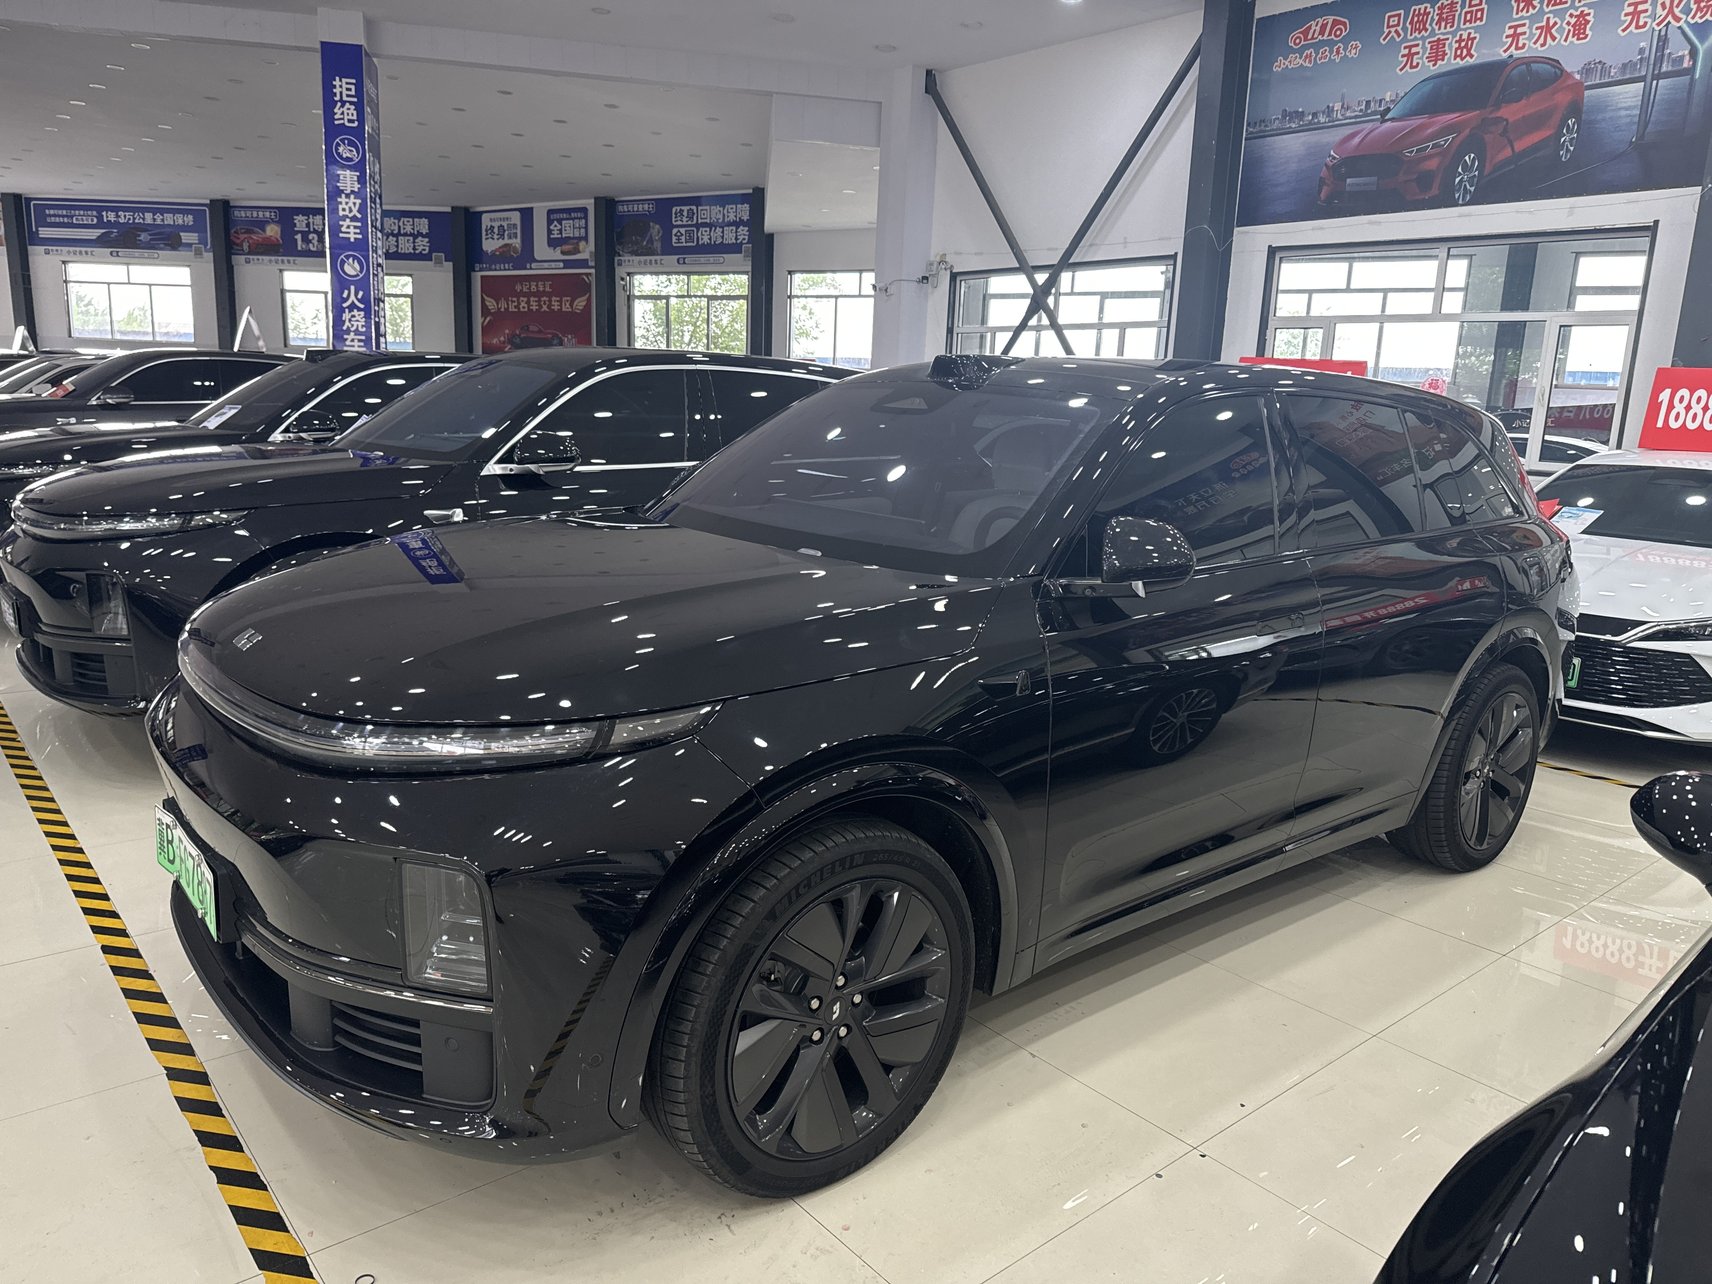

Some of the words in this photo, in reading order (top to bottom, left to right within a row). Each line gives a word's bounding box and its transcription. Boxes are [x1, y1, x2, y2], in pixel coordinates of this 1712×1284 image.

[1381, 0, 1486, 42] 只做精品
[1398, 31, 1478, 72] 无事故
[1501, 9, 1592, 53] 无水淹
[332, 77, 358, 127] 拒绝
[336, 170, 362, 242] 事故车
[550, 220, 573, 238] 全国
[498, 296, 572, 312] 小记名车交车区
